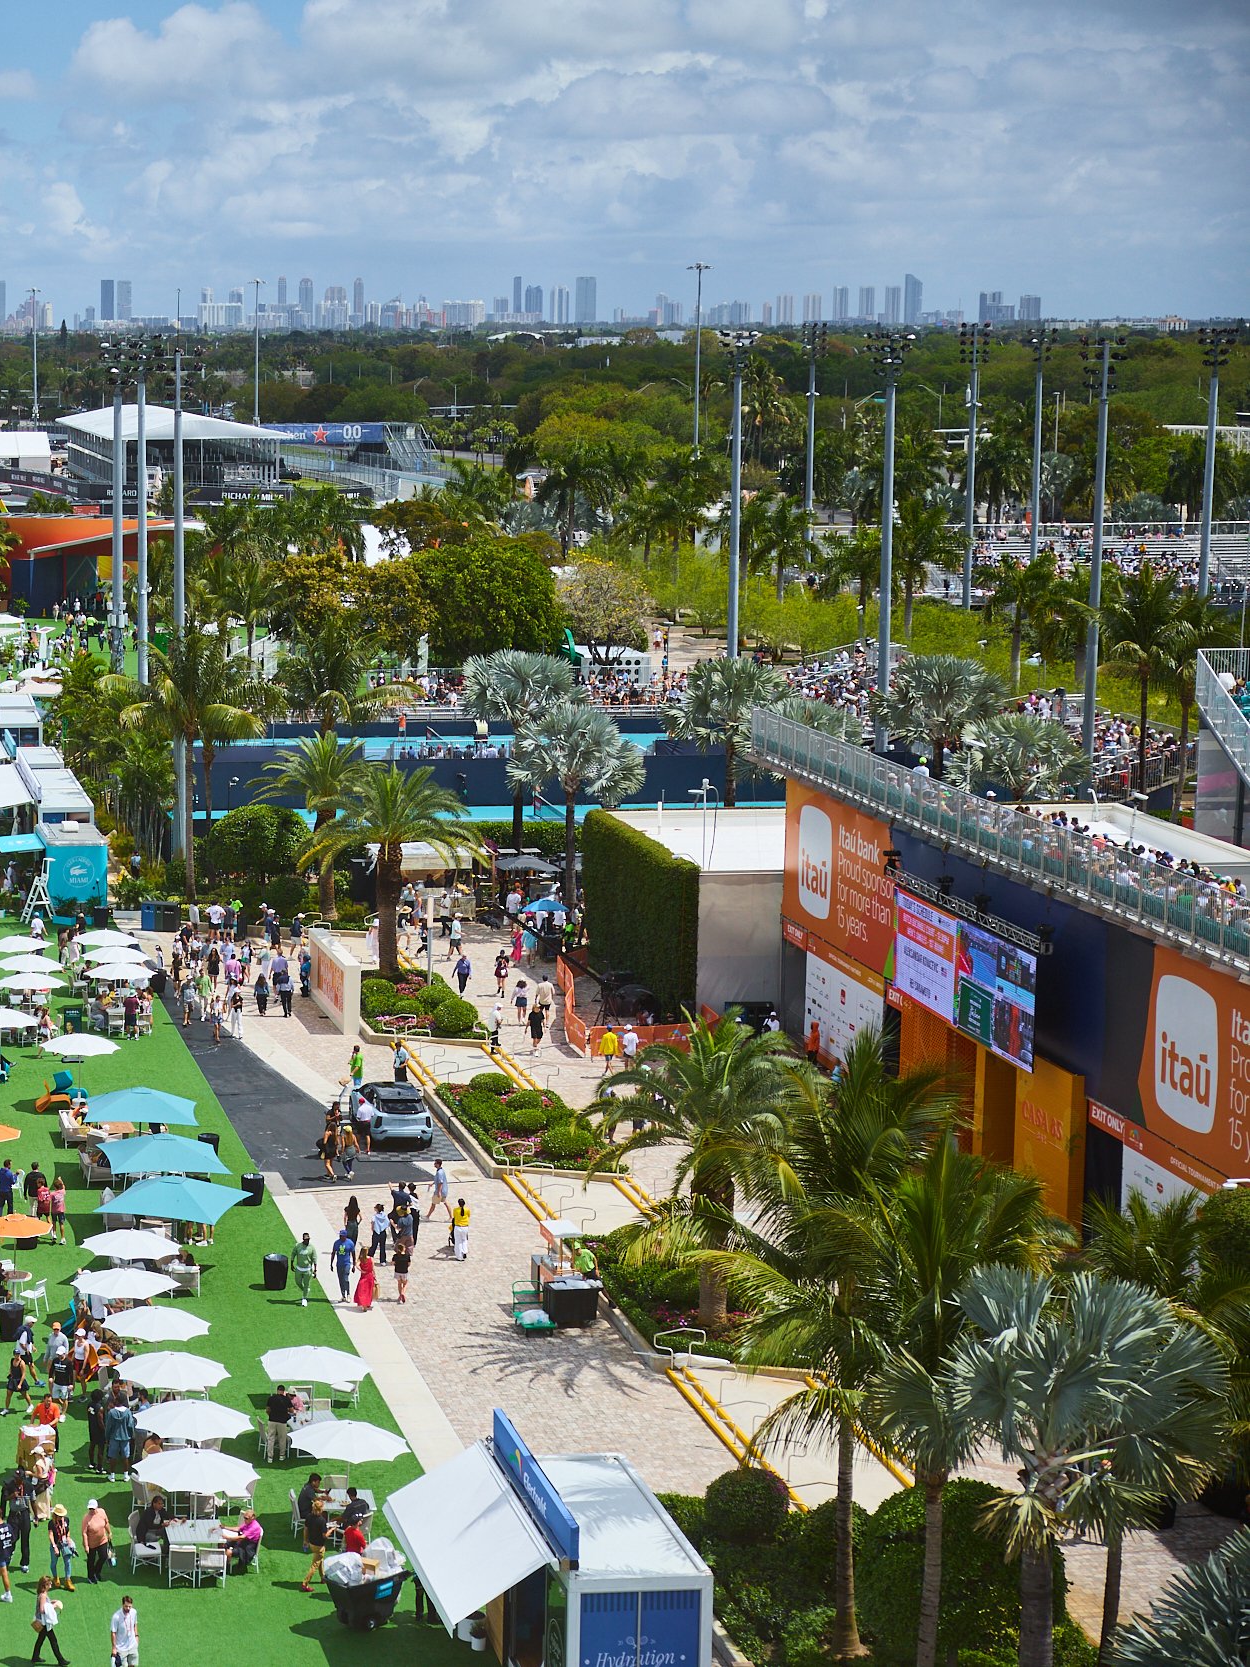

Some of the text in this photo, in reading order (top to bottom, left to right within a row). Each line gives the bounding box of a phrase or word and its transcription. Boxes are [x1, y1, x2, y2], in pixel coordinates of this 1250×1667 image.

[838, 824, 880, 866] Itaú bank
[801, 848, 828, 900] itaú
[838, 851, 895, 900] Proud sponsor
[836, 876, 891, 927] for more than
[836, 904, 868, 942] 15 years.
[888, 988, 900, 1004] EXIT
[1231, 1008, 1250, 1045] Ita
[1160, 1031, 1211, 1108] itaú
[1230, 1044, 1250, 1083] Pro
[1230, 1078, 1250, 1117] for
[1022, 1100, 1050, 1134] CASA
[1092, 1105, 1126, 1134] EXIT ONLY
[1228, 1116, 1242, 1150] 15
[1170, 1156, 1188, 1173] OFFICIAL
[1188, 1166, 1216, 1190] TOURNAMENT
[523, 1472, 547, 1519] Electrolit
[596, 1650, 676, 1667] Hydration
